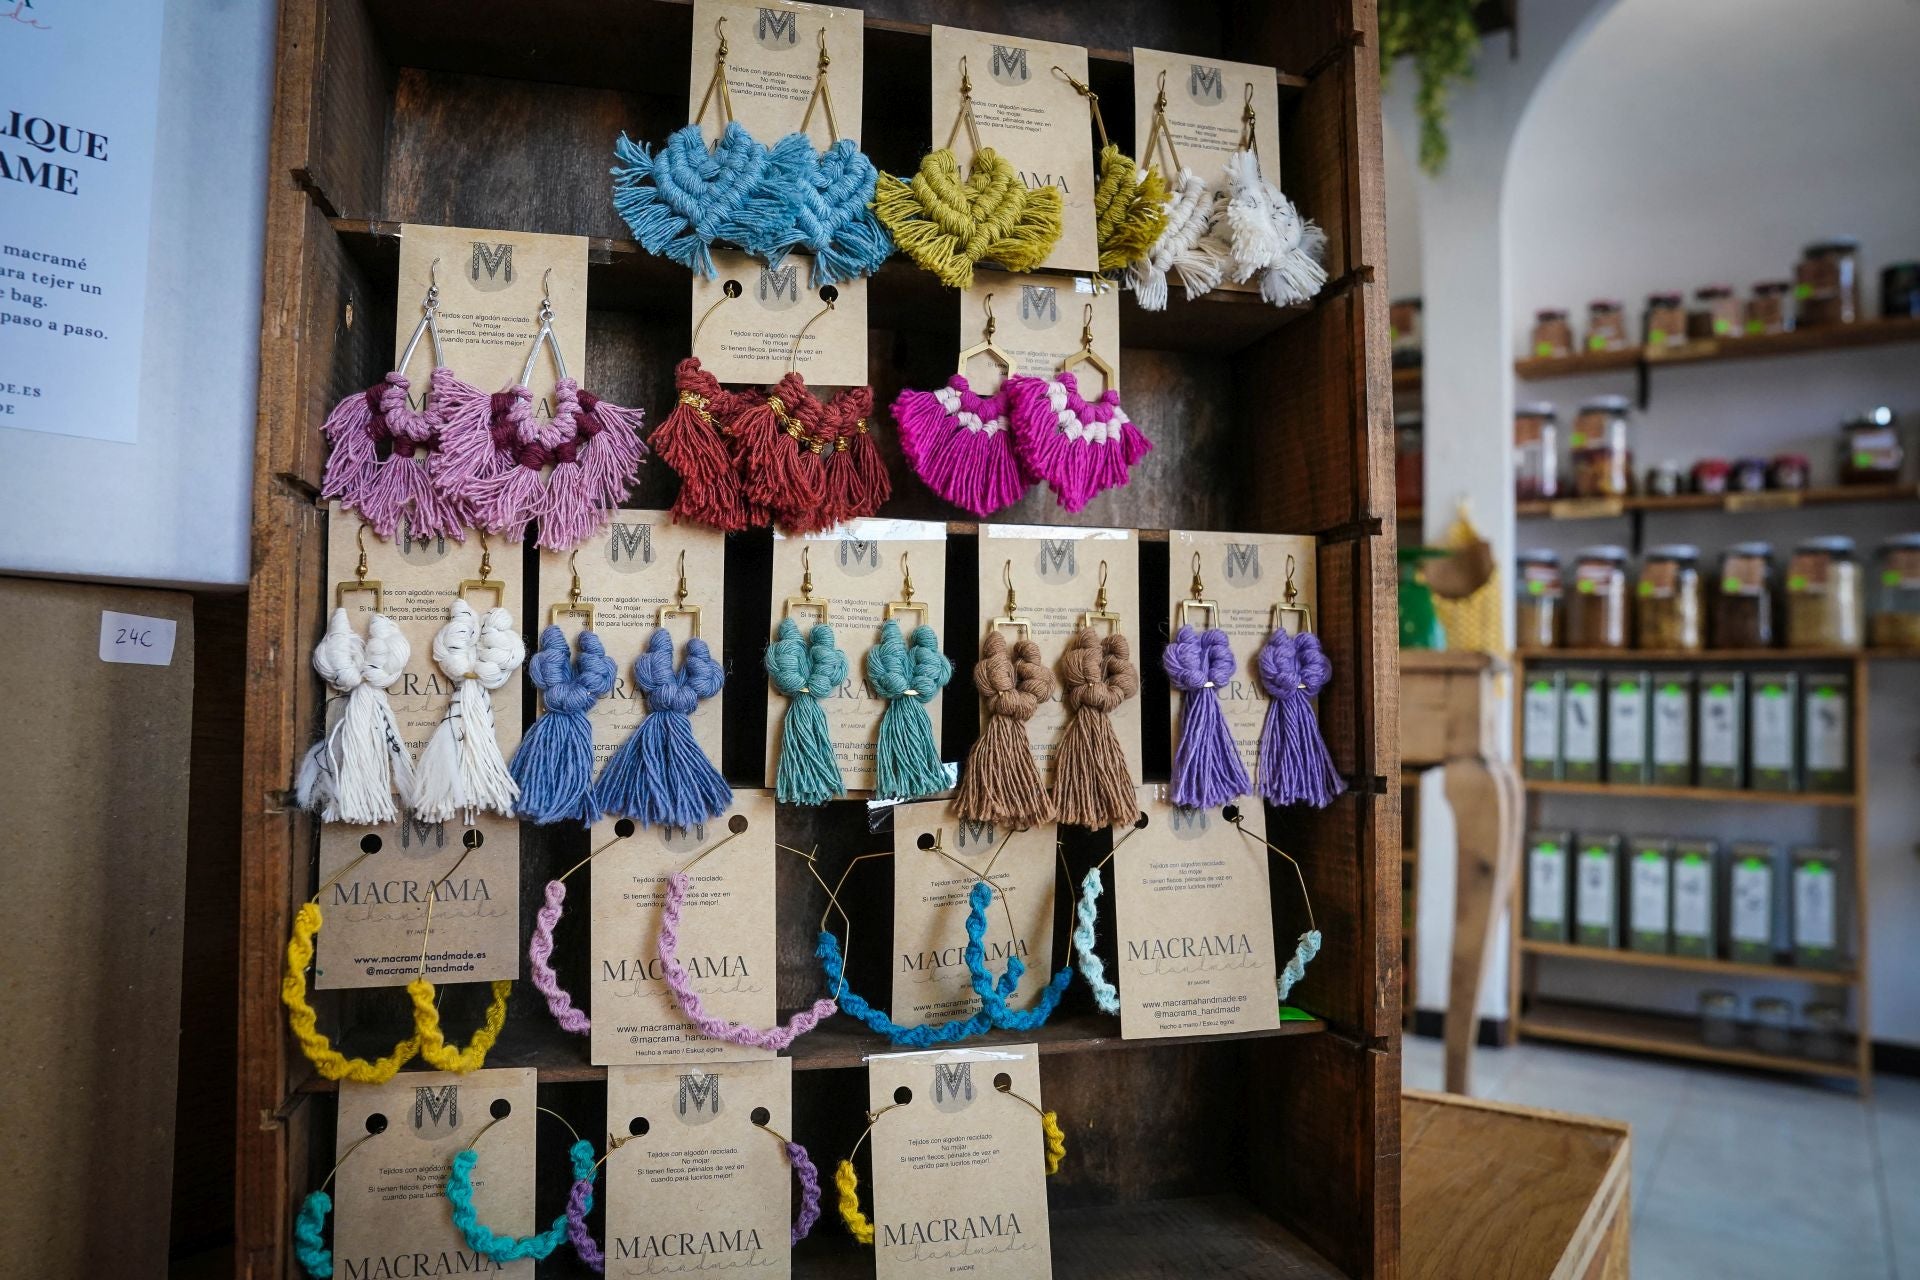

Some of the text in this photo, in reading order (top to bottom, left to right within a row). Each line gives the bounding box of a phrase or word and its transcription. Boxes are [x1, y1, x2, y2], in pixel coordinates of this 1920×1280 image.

[0, 110, 108, 161] IQUE
[4, 245, 87, 270] macramé
[32, 272, 75, 288] tejer
[81, 283, 102, 295] un
[11, 287, 48, 308] bag.
[0, 312, 108, 340] paso a paso.
[332, 878, 492, 906] MACRAMA
[1127, 933, 1252, 961] MACRAMA
[602, 955, 750, 982] MACAMA
[1142, 994, 1248, 1009] www.macramahandmade.es
[1154, 1005, 1241, 1019] @macrama_handmade
[883, 1213, 1022, 1246] MACRAMA
[614, 1228, 764, 1260] MACRAMA
